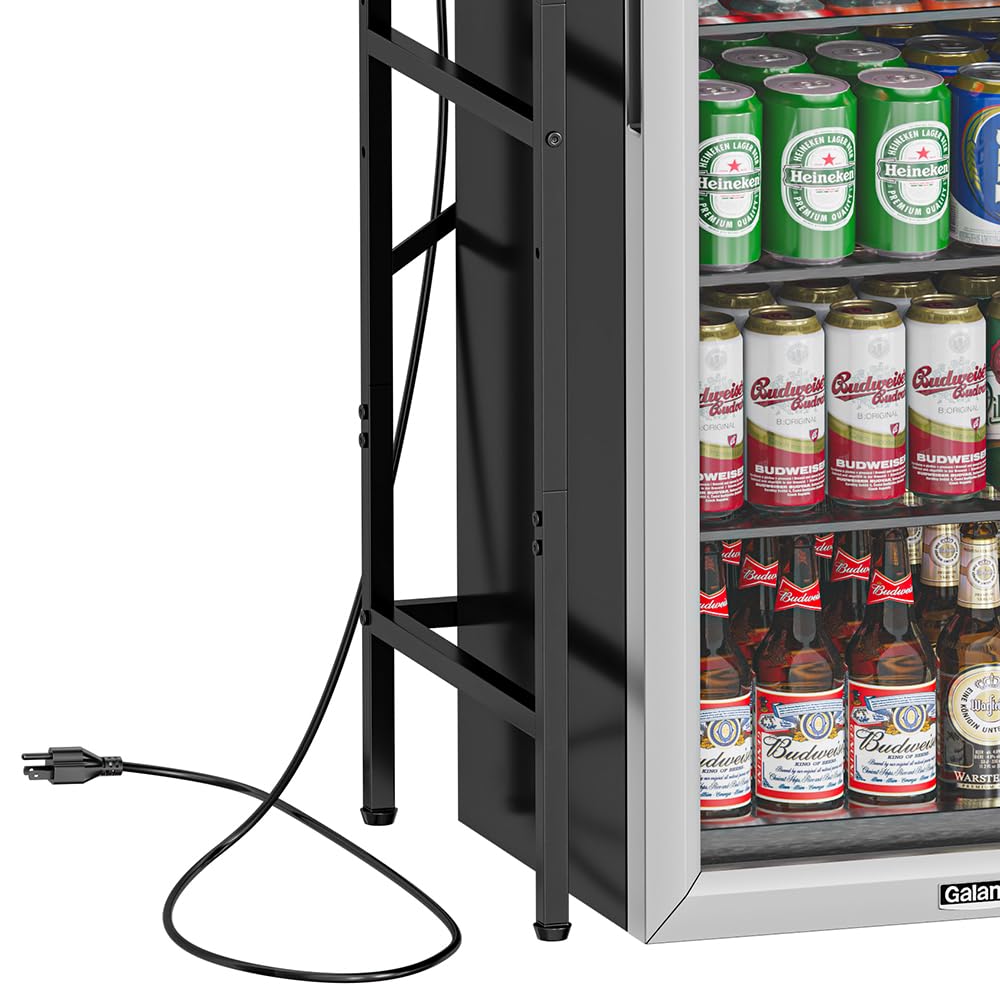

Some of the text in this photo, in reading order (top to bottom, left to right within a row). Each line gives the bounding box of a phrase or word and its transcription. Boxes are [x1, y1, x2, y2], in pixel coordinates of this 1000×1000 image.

[699, 142, 730, 168] HEINEKEN
[732, 141, 754, 153] LAGER
[793, 136, 825, 162] HEINEKEN
[827, 135, 849, 146] LAGER
[887, 129, 919, 156] HEINEKEN
[922, 129, 943, 139] LAGER
[699, 176, 760, 190] Heineken
[790, 168, 854, 184] Heineken
[884, 163, 948, 178] Heineken
[700, 200, 758, 228] PREMIUM QUALITY
[793, 194, 853, 222] PREMIUM QUALITY
[888, 188, 947, 216] PREMIUM QUALITY
[960, 687, 974, 702] EINE
[960, 704, 980, 730] KÖNIGIN
